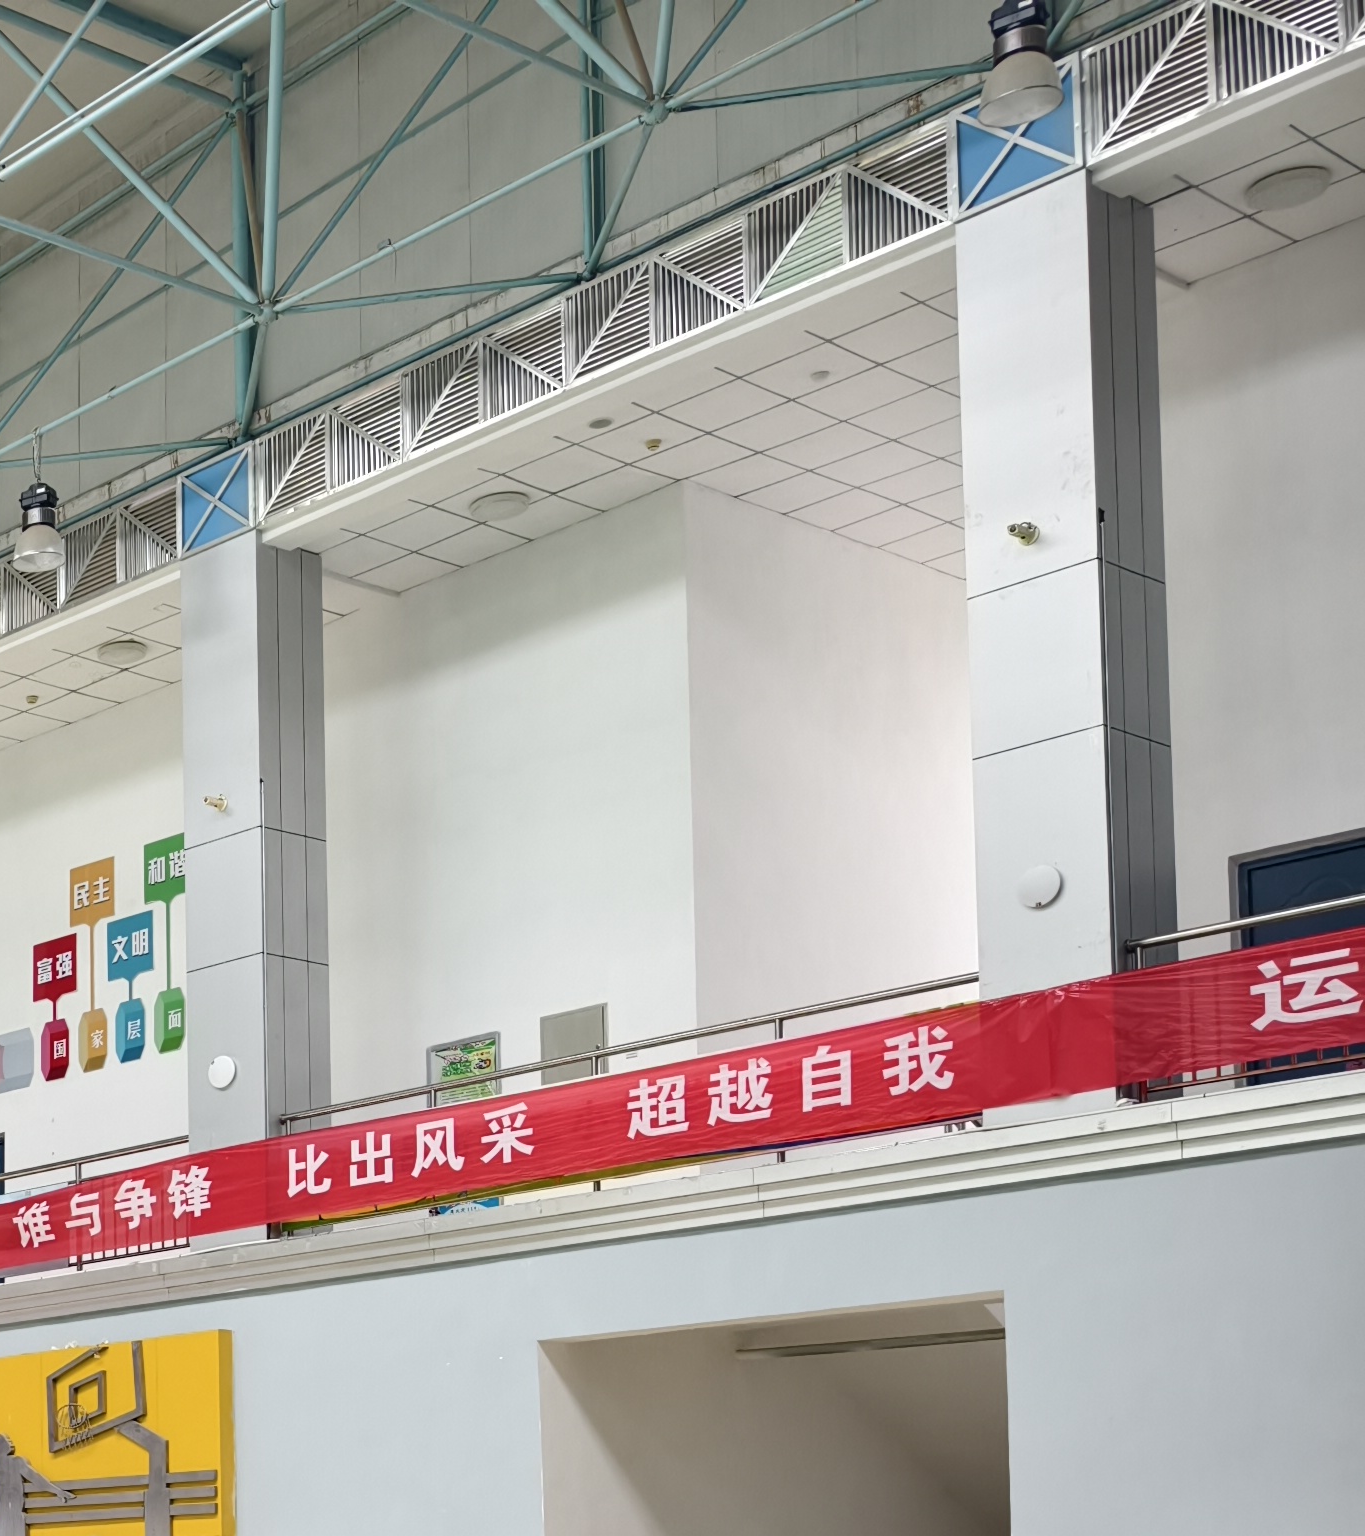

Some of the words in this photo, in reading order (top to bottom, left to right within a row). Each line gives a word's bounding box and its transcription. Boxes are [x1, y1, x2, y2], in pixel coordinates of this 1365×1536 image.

[73, 876, 110, 911] 民主
[111, 927, 149, 964] 文明
[37, 951, 73, 985] 富强
[1250, 948, 1363, 1031] 运
[12, 1165, 213, 1250] 谁与争锋
[286, 1102, 536, 1198] 比出风采
[626, 1025, 956, 1140] 超越自我
